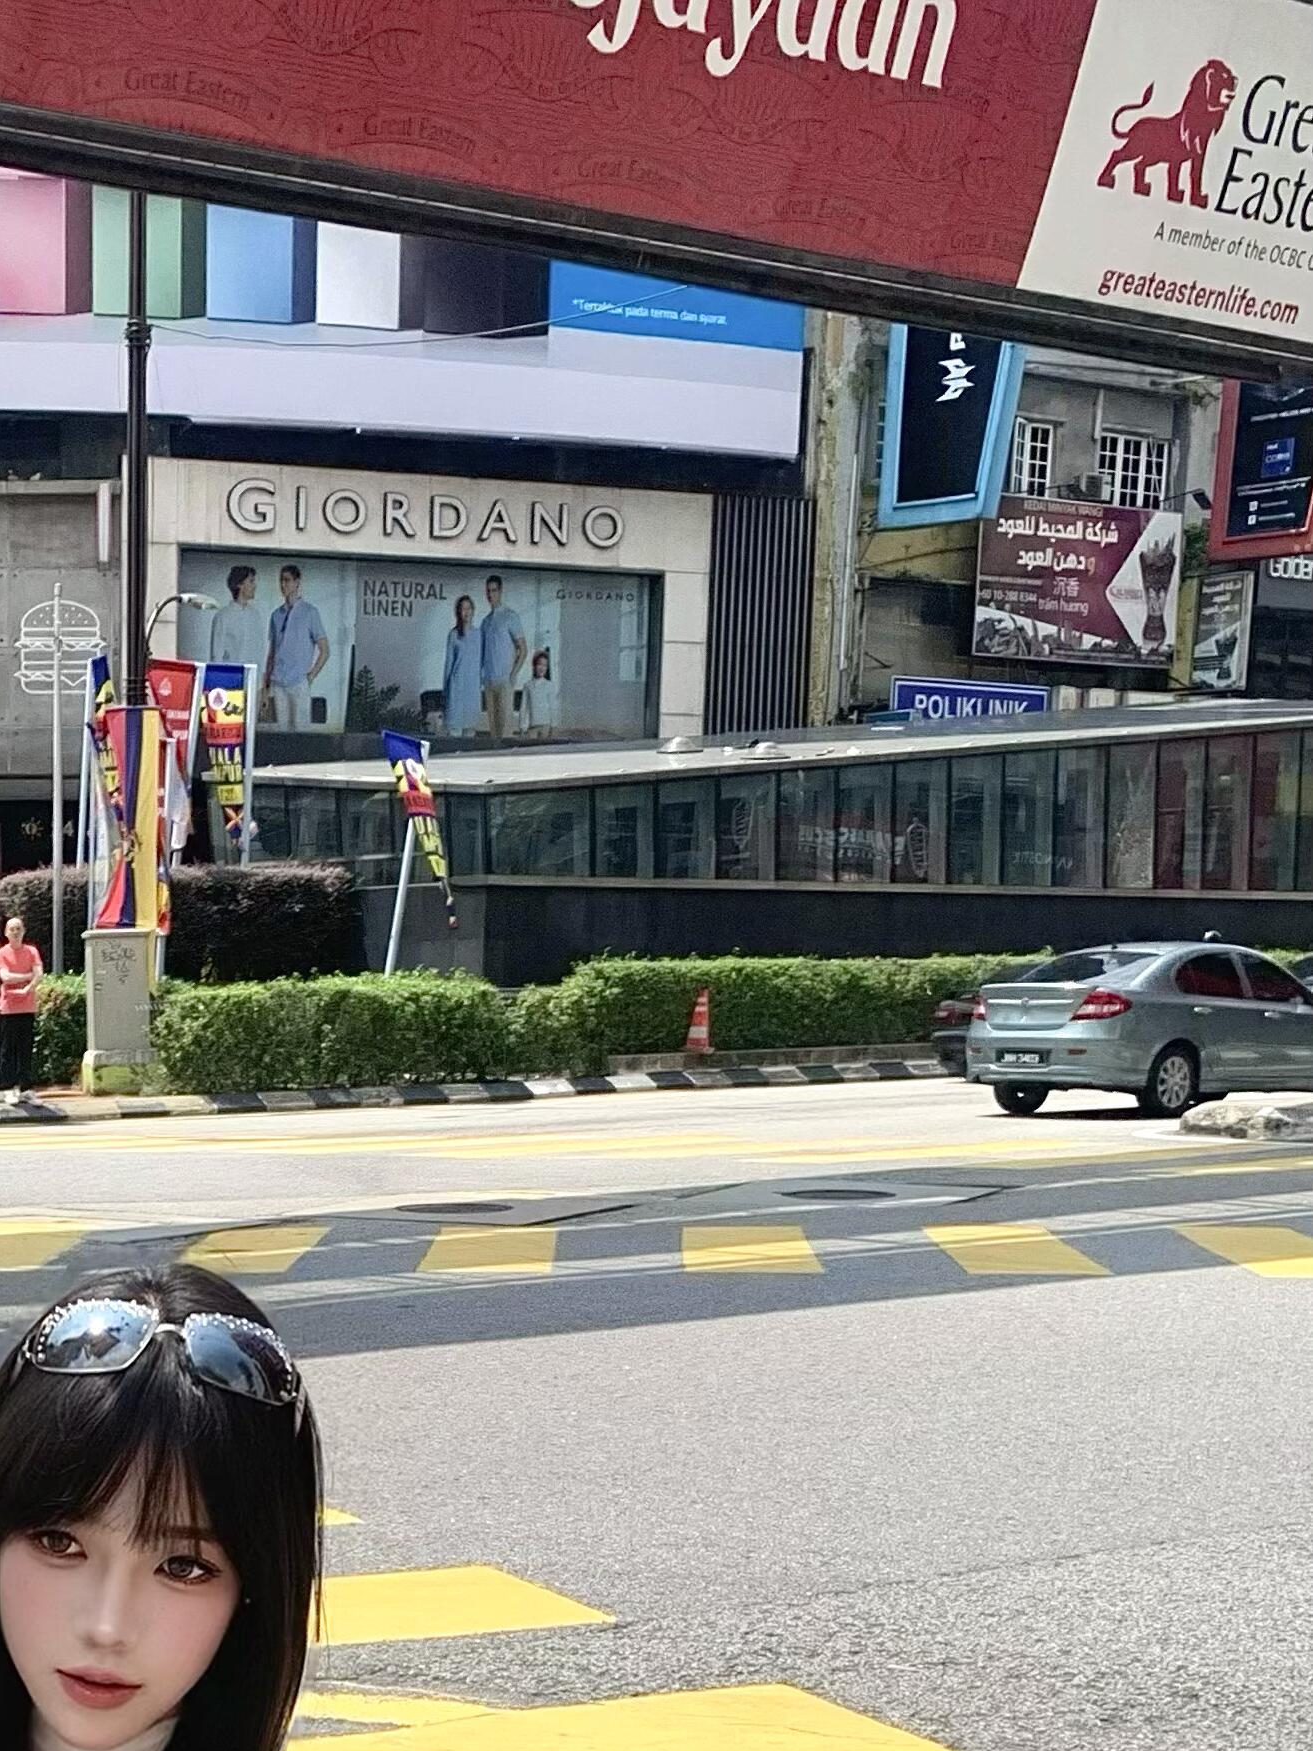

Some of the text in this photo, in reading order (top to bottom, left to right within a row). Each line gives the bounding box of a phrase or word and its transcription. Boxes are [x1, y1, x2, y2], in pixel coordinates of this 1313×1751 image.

[1153, 220, 1165, 241] A
[1167, 225, 1226, 253] member
[1227, 236, 1246, 256] of
[1245, 239, 1267, 261] the
[1269, 245, 1305, 270] OCBC
[1097, 267, 1300, 325] greateasternlife.com
[225, 476, 626, 550] GIORDANO
[1085, 520, 1119, 547] شركة
[362, 578, 447, 602] NATURAL
[555, 588, 636, 603] GIORDANO
[361, 597, 414, 618] LINEN
